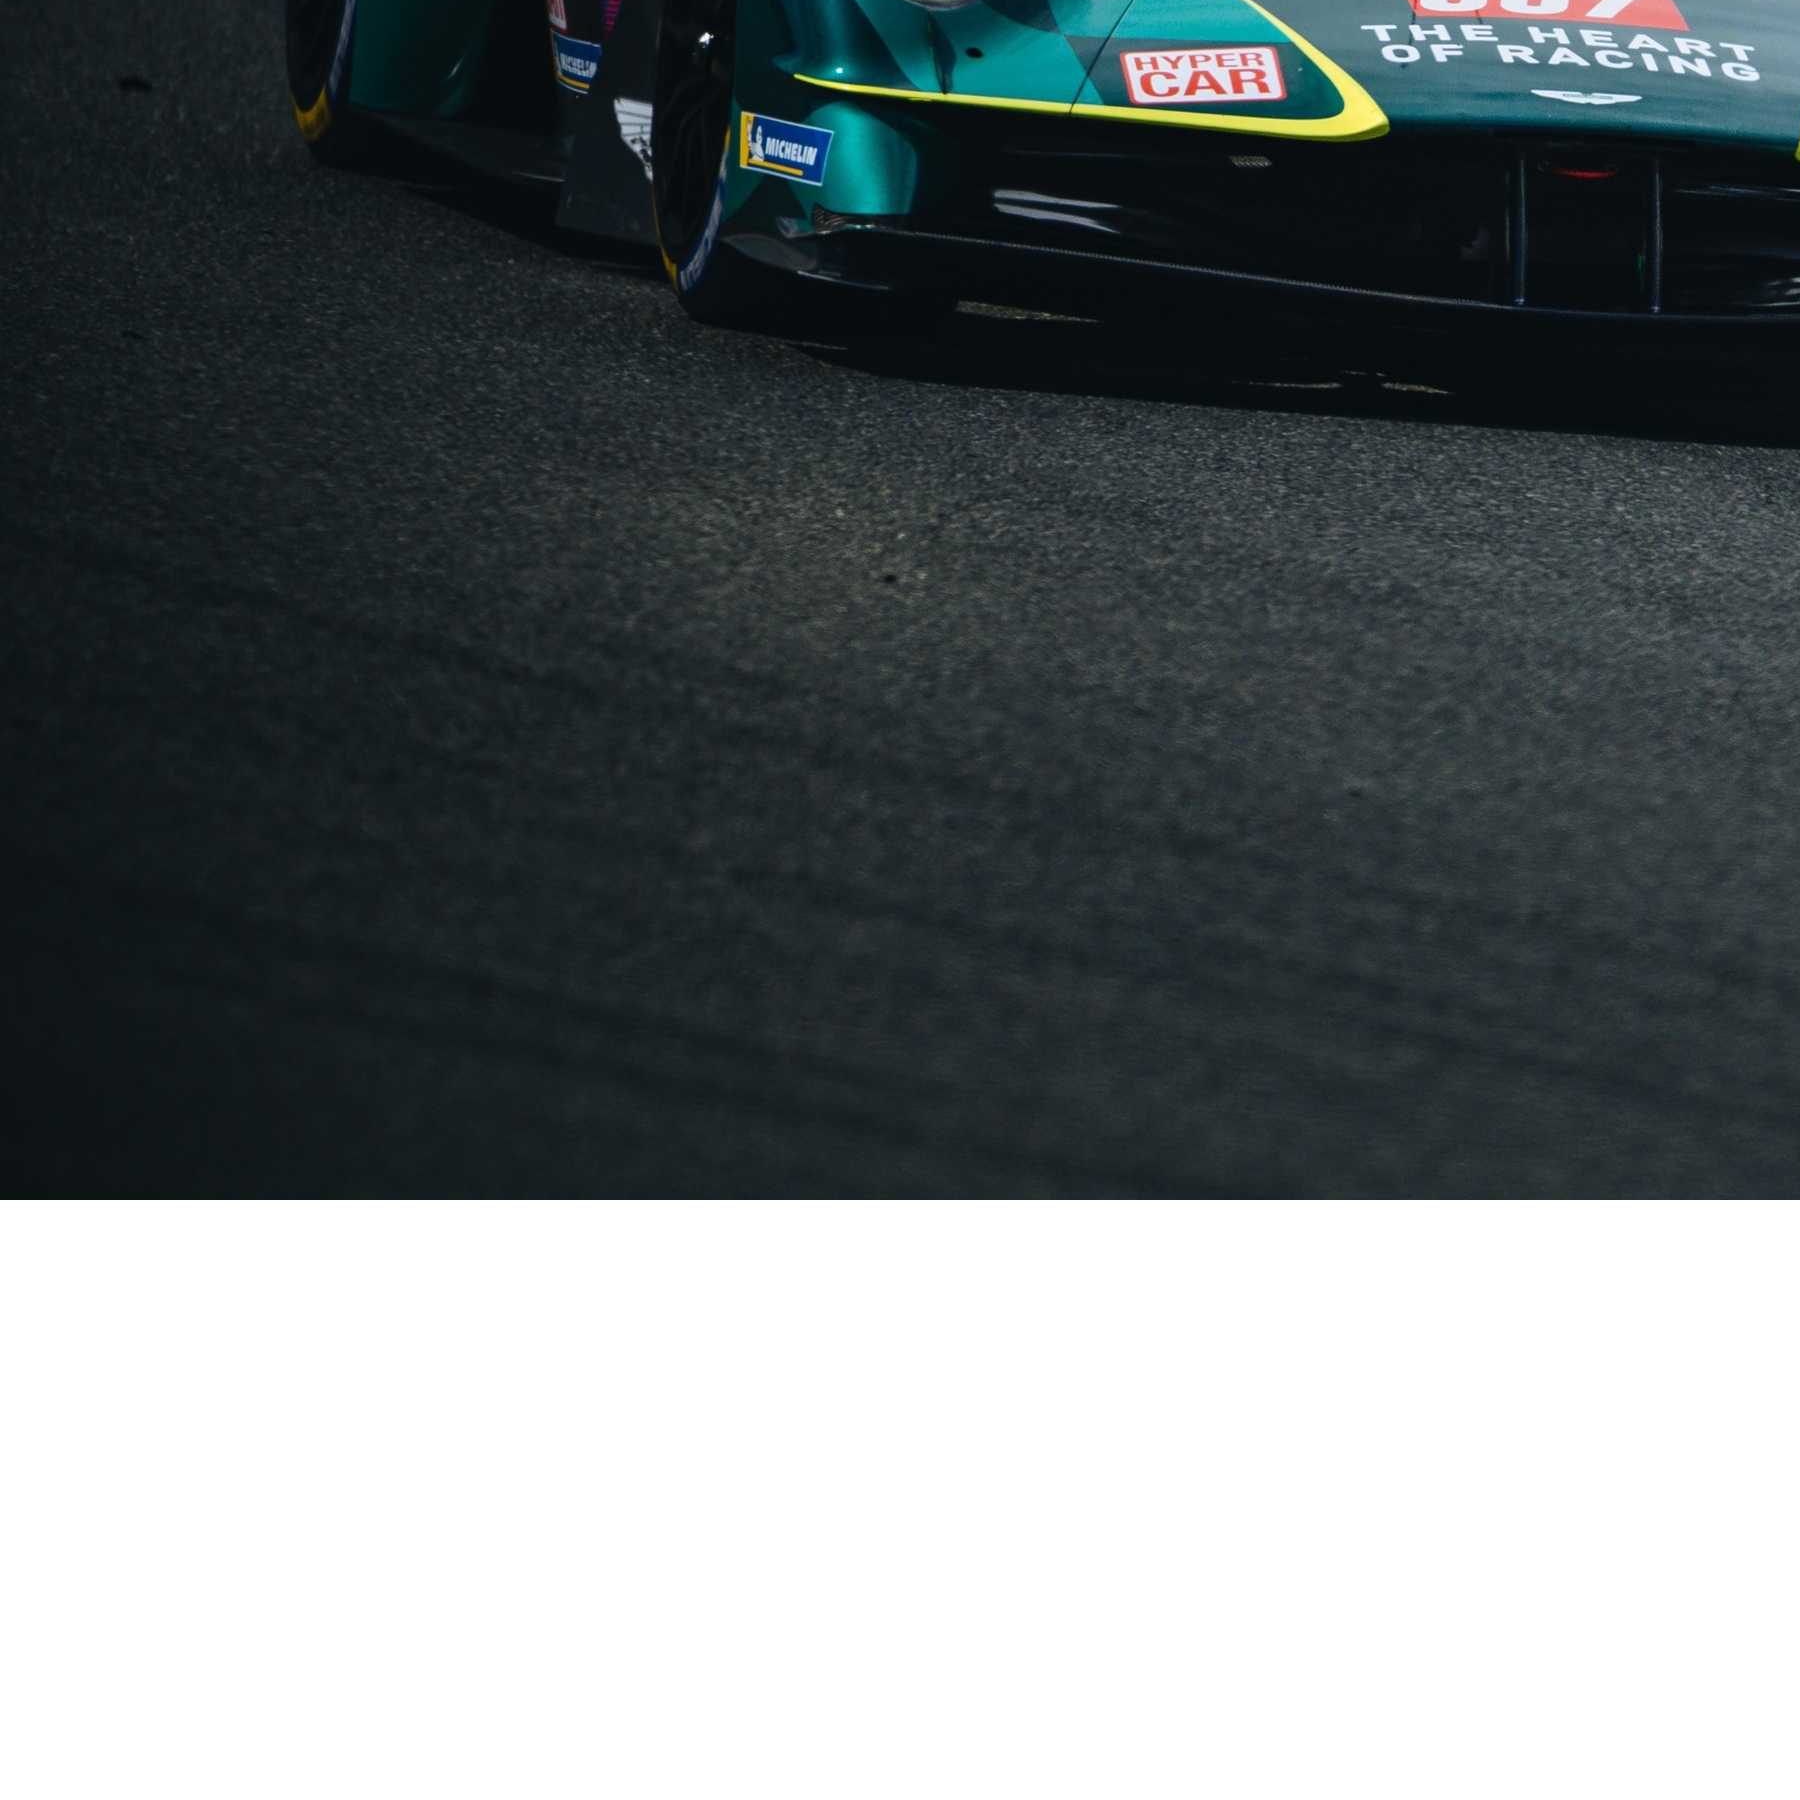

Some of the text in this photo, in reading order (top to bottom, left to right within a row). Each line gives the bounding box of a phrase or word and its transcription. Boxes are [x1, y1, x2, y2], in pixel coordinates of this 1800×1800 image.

[1361, 24, 1755, 62] THE HEART
[1133, 53, 1265, 71] HYPER
[1381, 43, 1761, 82] OF RACING
[1140, 68, 1271, 98] CAR
[765, 137, 818, 166] MICHELIN
